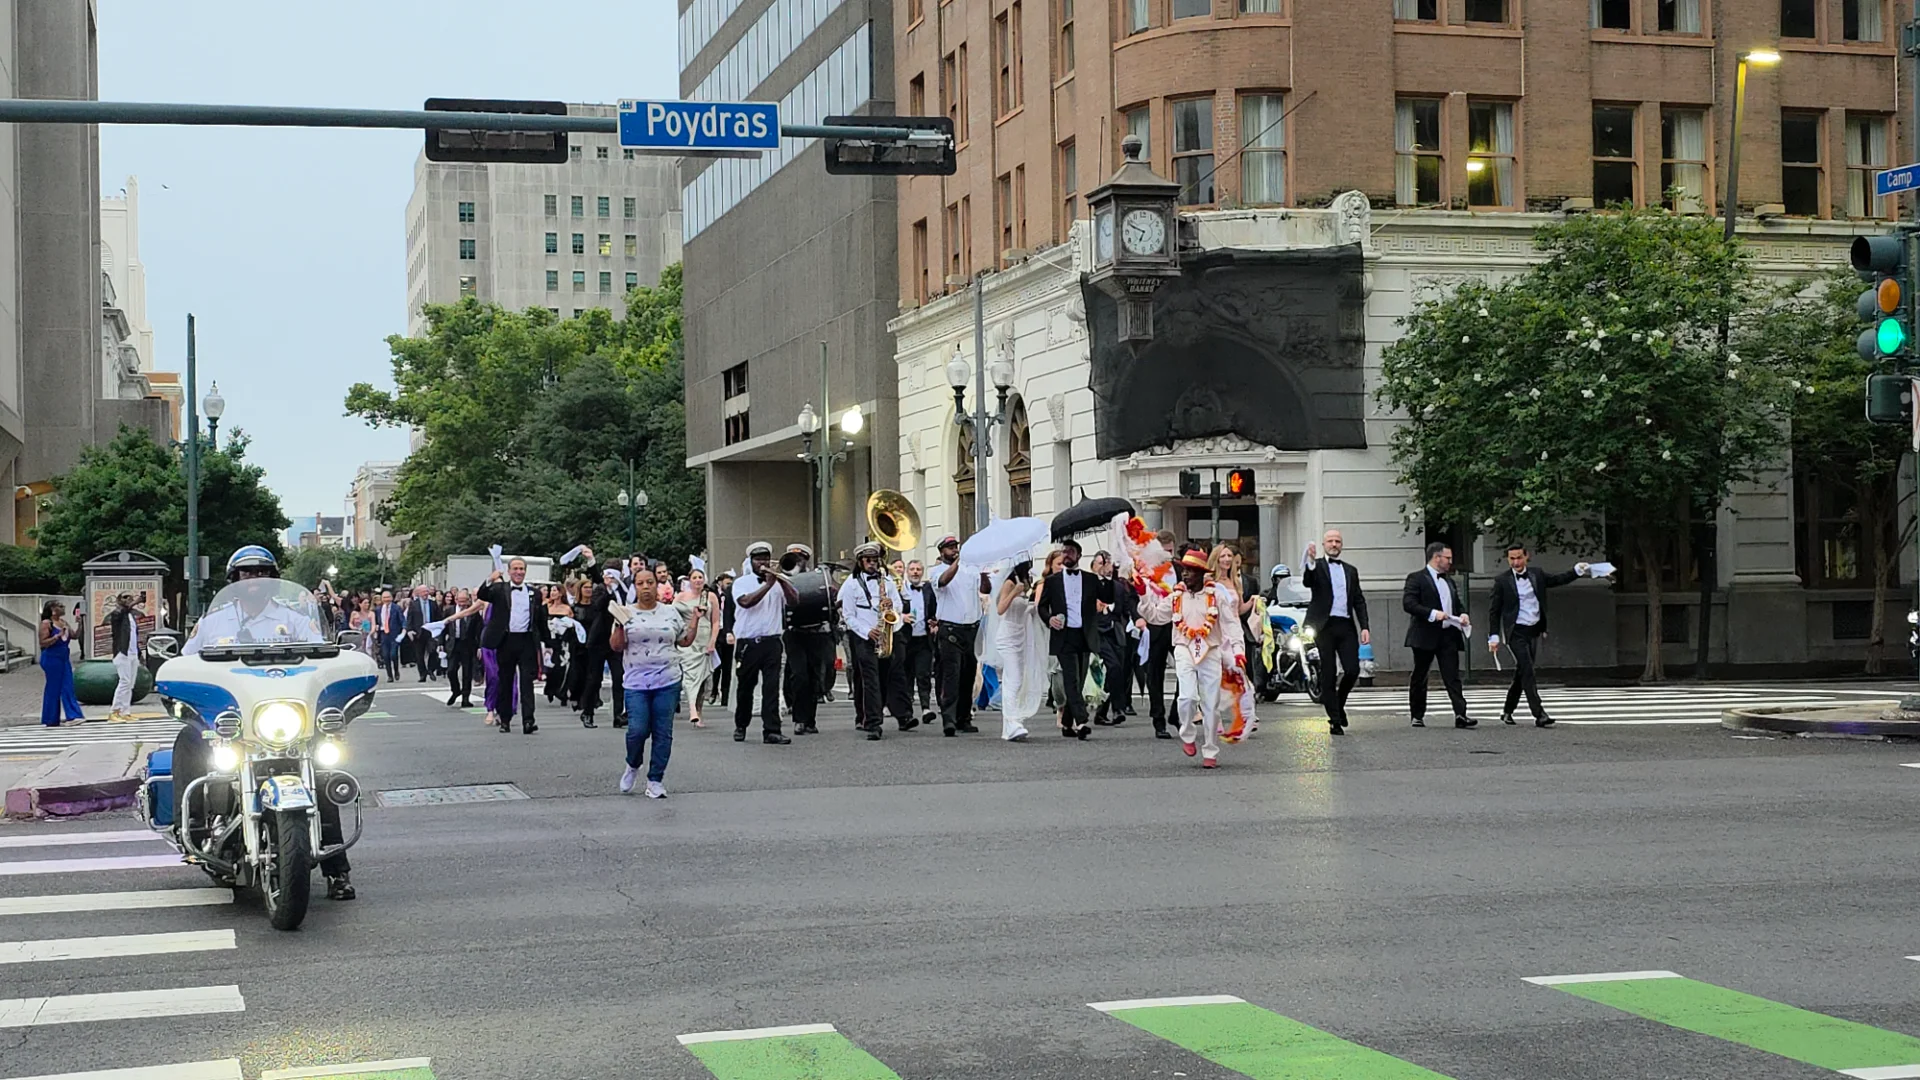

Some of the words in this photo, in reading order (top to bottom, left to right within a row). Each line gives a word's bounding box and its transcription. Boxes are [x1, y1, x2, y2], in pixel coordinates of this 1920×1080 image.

[647, 103, 768, 146] Poydras
[1887, 171, 1913, 187] Camp
[281, 788, 304, 796] E-48
